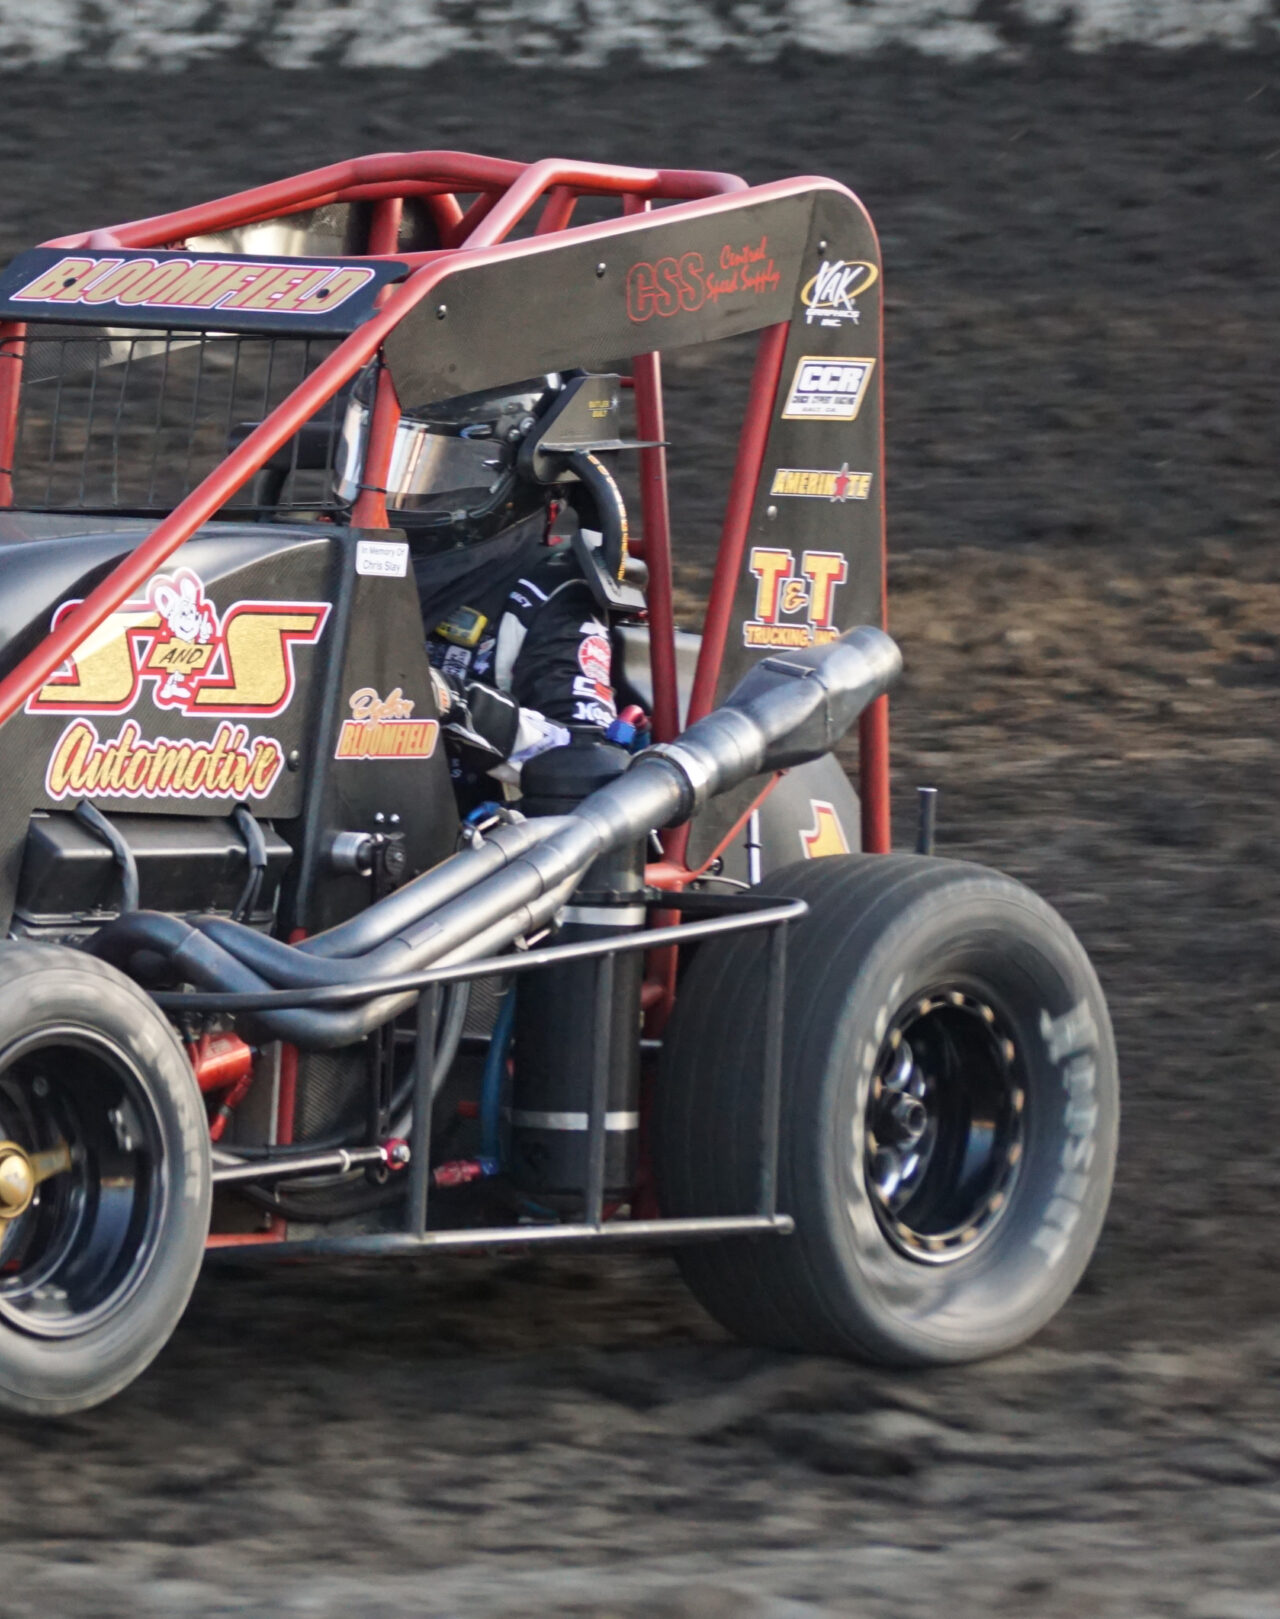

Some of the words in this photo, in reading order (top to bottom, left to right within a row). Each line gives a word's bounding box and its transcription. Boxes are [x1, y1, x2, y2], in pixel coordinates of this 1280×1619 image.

[720, 236, 767, 270] Central
[10, 257, 375, 314] BLOOMFIELD
[626, 252, 706, 322] CSS
[705, 271, 739, 303] Speed
[740, 259, 782, 293] Supply
[810, 260, 865, 312] YAK
[797, 364, 866, 394] CCR
[749, 547, 848, 630] T&T
[159, 648, 205, 665] AND
[184, 602, 332, 717] S
[46, 718, 284, 800] Automotive
[335, 719, 439, 760] BLOOMFIELD
